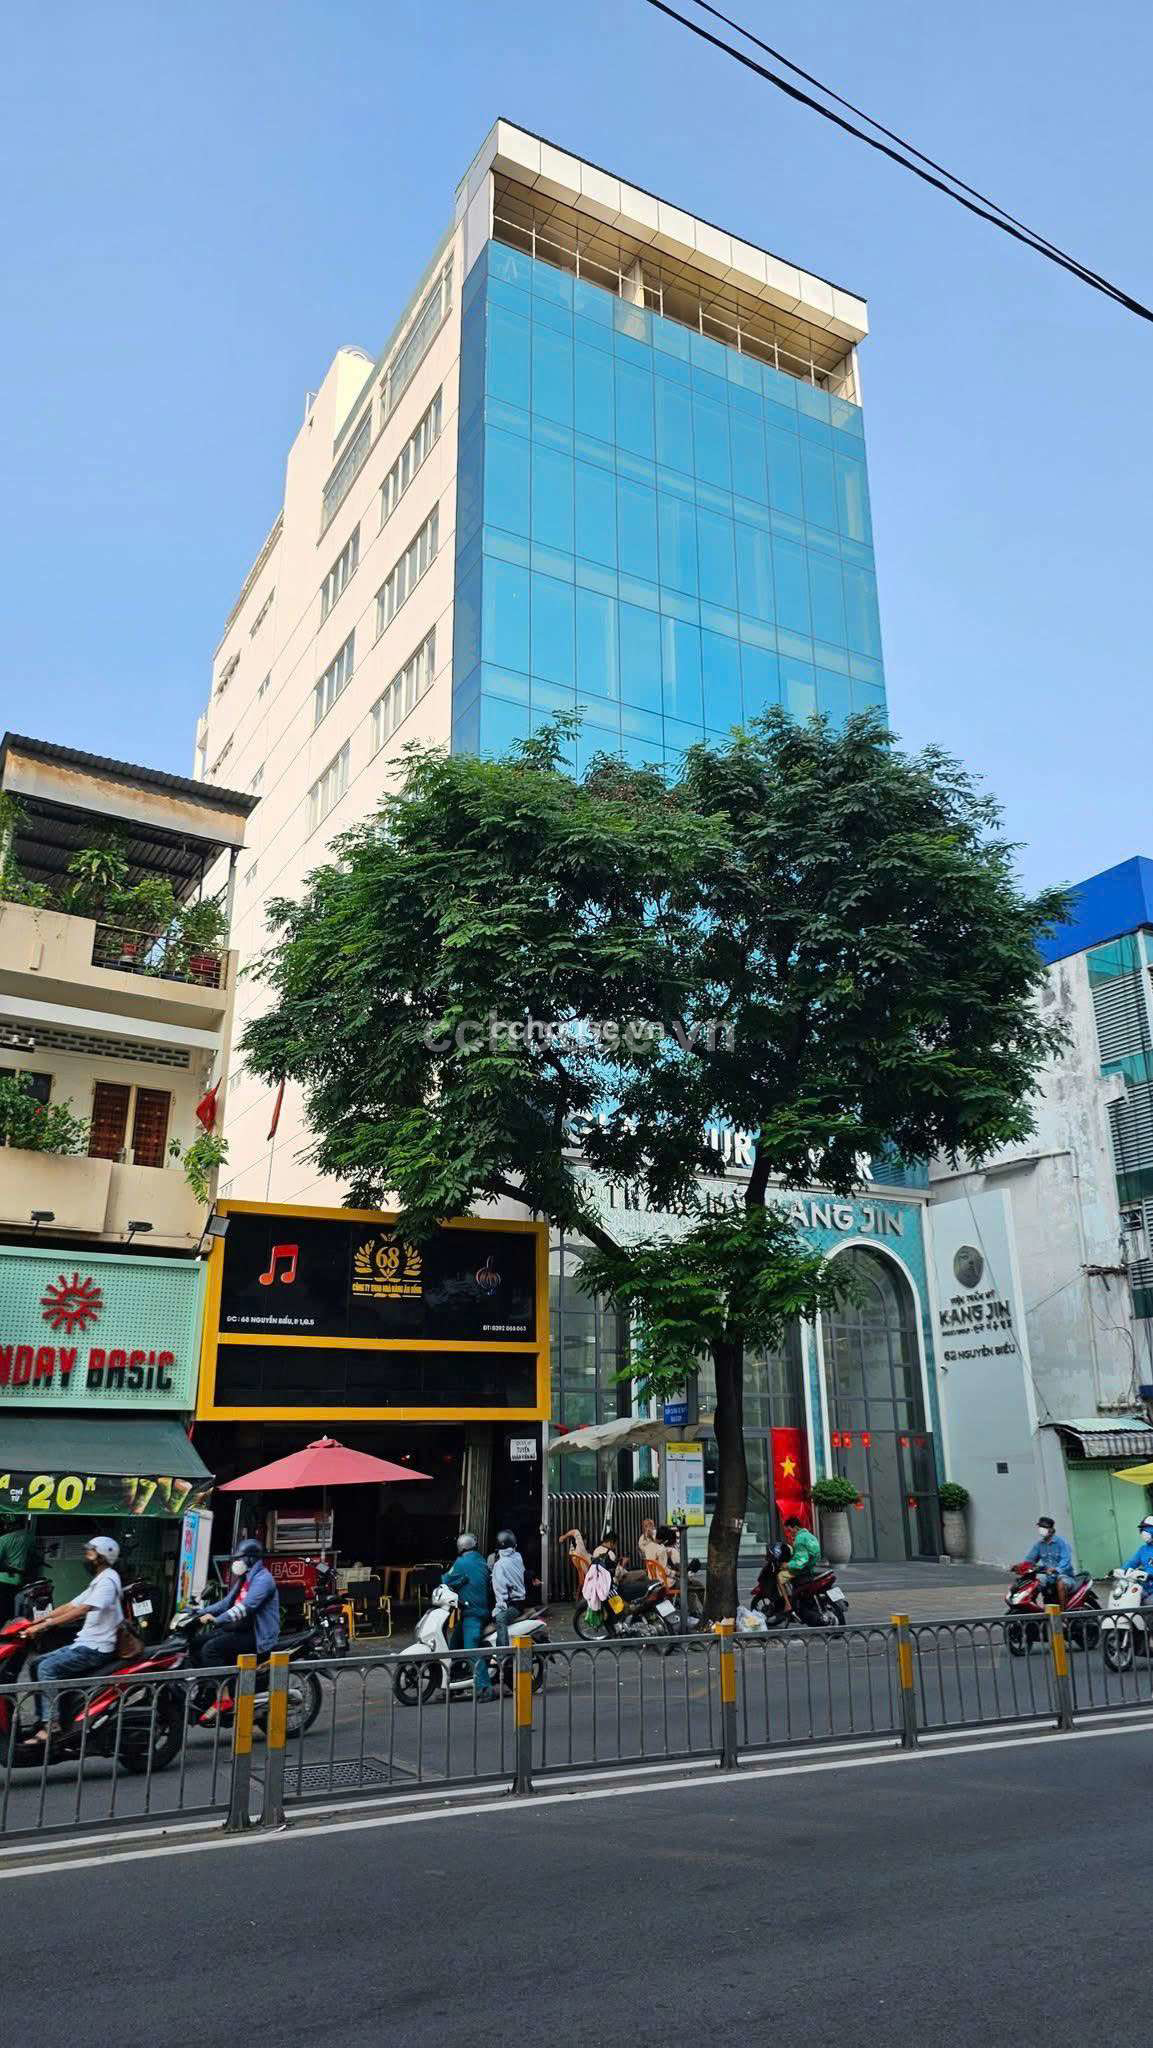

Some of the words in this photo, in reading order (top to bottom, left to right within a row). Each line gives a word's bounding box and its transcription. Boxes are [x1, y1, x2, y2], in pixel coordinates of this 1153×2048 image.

[860, 1207, 904, 1237] JIN
[375, 1246, 400, 1269] 68
[939, 1305, 983, 1328] KANG
[985, 1300, 1010, 1320] JIN
[944, 1350, 957, 1361] 62
